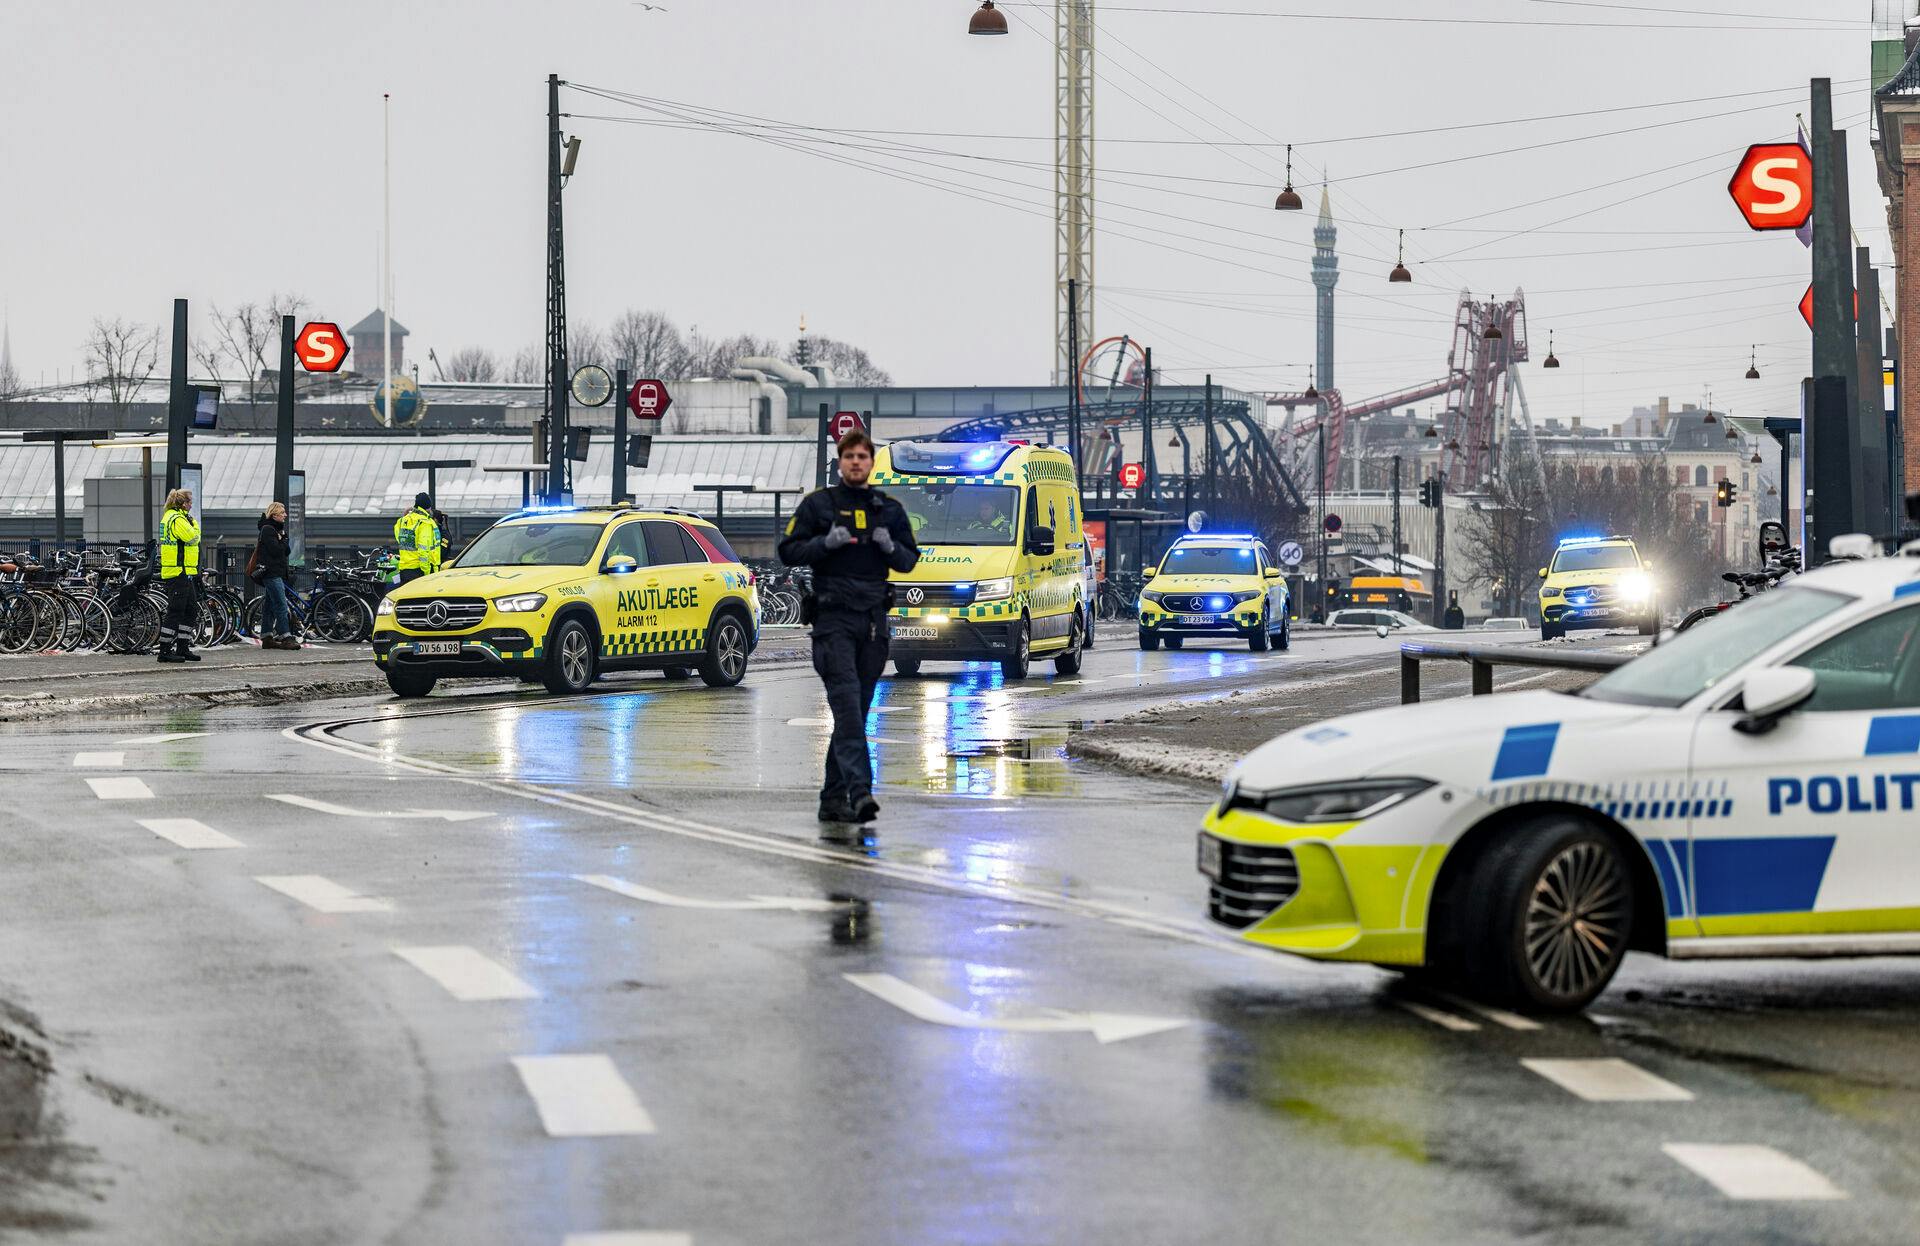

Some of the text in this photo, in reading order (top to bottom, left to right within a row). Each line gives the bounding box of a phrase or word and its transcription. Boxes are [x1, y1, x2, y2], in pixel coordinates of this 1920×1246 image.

[1751, 157, 1802, 214] S
[306, 331, 335, 363] S
[1282, 547, 1301, 561] 40
[617, 586, 699, 612] AKUTLÆGE
[617, 614, 658, 628] ALARM 112
[896, 628, 937, 637] DM 60 062
[419, 643, 459, 653] DV 56 198
[1768, 773, 1920, 816] POLIT
